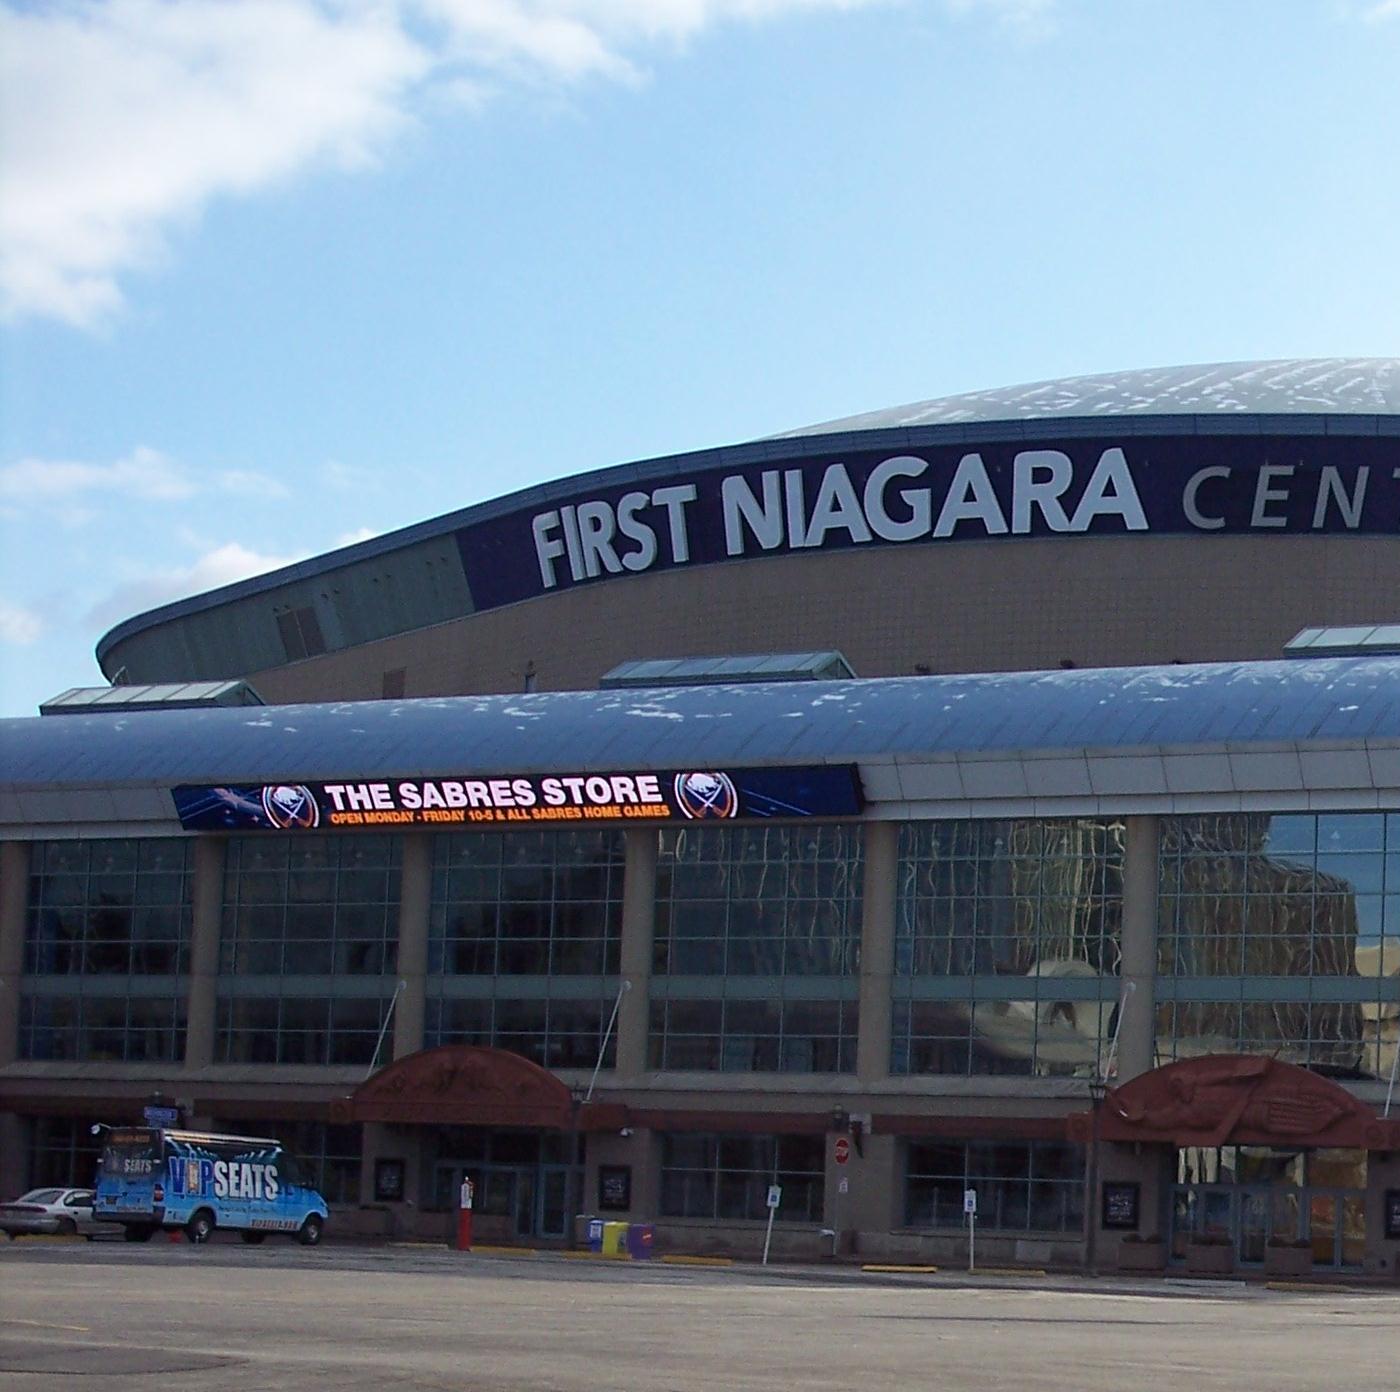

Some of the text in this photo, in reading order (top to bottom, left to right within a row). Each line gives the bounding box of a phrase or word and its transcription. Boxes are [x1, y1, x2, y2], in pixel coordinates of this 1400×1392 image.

[532, 484, 697, 588] FIRST
[721, 447, 1149, 556] NIAGARA
[324, 775, 663, 811] THE SABRES STORE
[331, 812, 363, 825] OPEN
[366, 811, 415, 824] MONDAY
[424, 810, 465, 822] FRIDAY
[468, 809, 494, 821] 10-5
[496, 808, 507, 821] &
[507, 808, 531, 821] ALL
[532, 807, 583, 820] SABRES
[584, 806, 623, 819] HOME
[625, 805, 671, 818] GAMES
[124, 1158, 152, 1173] SEATS
[215, 1160, 279, 1200] SEATS
